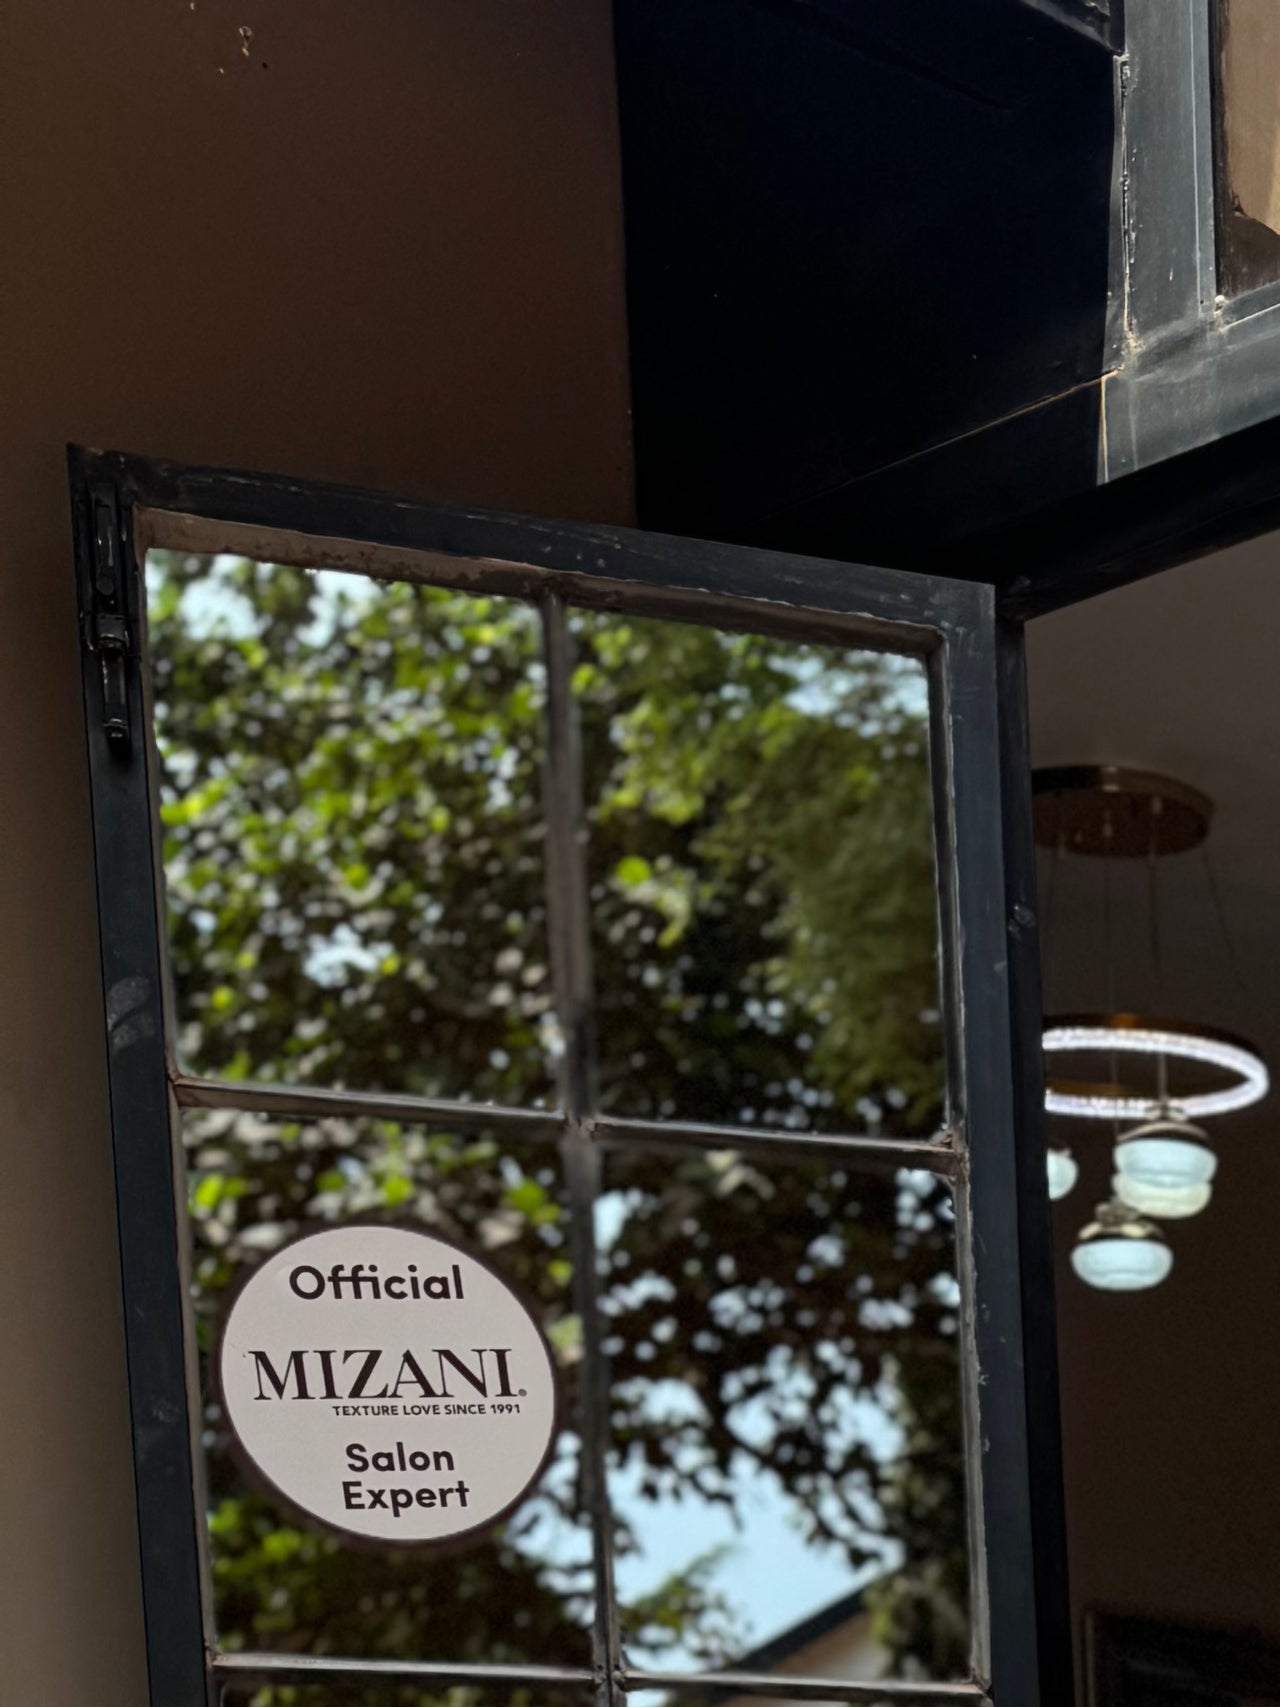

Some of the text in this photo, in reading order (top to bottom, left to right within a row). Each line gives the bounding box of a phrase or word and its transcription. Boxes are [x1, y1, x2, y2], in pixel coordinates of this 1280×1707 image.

[288, 1264, 465, 1301] Official
[331, 1403, 521, 1417] TEXTURE LOVE SINCE 1991
[345, 1441, 456, 1473] Salon
[341, 1480, 470, 1518] Expert
